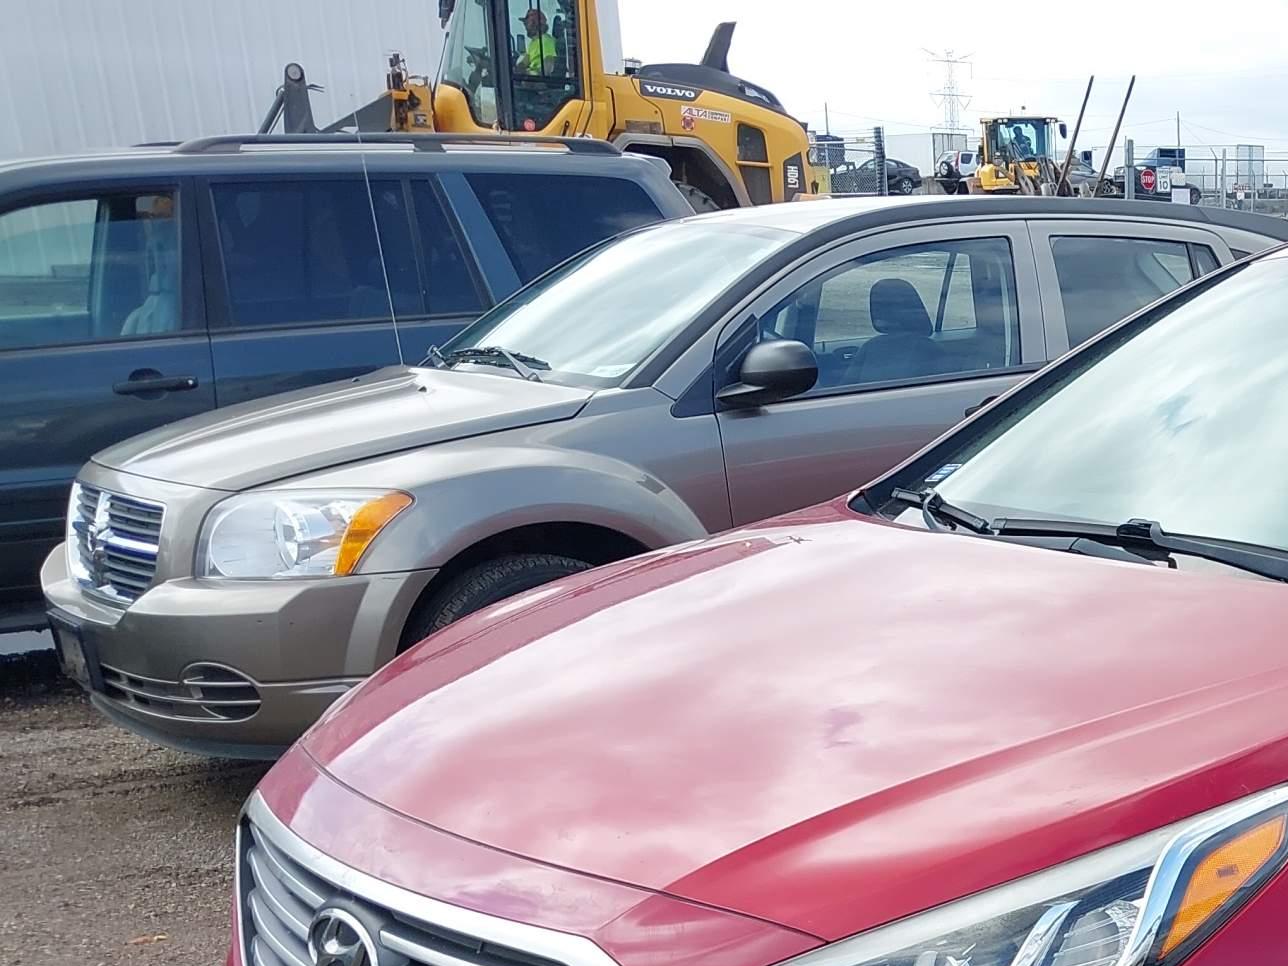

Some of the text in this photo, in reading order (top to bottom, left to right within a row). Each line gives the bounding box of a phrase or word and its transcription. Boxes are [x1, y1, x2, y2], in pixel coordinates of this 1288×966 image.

[644, 84, 696, 98] VOLVO
[683, 107, 707, 119] ALTA
[787, 165, 799, 188] L90H
[1142, 175, 1155, 184] STOP
[1159, 180, 1168, 190] 10
